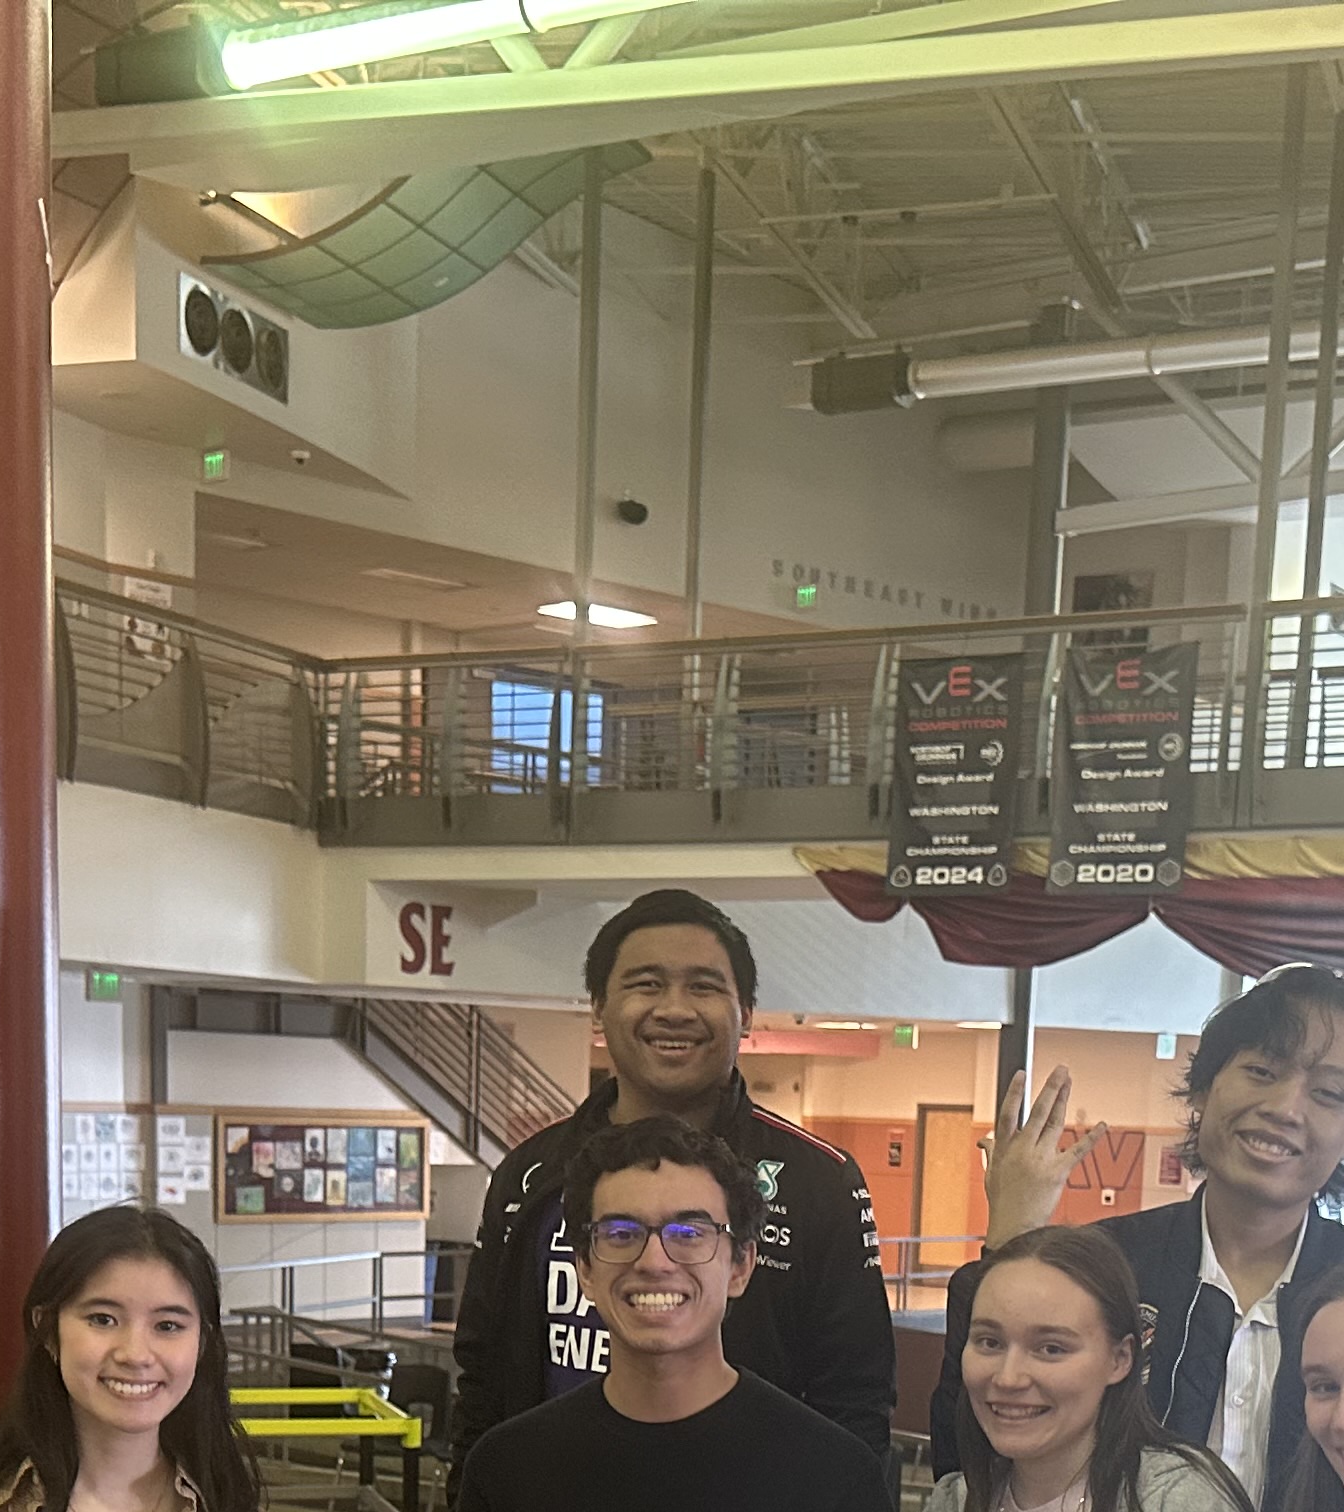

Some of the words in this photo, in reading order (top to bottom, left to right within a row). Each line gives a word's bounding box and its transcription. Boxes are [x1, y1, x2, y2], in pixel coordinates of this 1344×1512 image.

[1080, 659, 1179, 696] VEX
[911, 666, 1008, 705] VEX
[1074, 711, 1179, 725] COMPETITION
[908, 718, 1008, 732] COMPETITION
[957, 772, 994, 783] Award
[1124, 767, 1165, 778] Award
[908, 804, 1000, 817] WASHINGTON
[1073, 801, 1169, 813] WASHINGTON
[931, 834, 969, 845] STATE
[1097, 832, 1136, 843] STATE
[905, 844, 998, 857] CHAMPIONSHIP
[1068, 842, 1167, 854] CHAMPIONSHIP
[915, 866, 984, 885] 2024
[1076, 864, 1154, 883] 2020
[400, 902, 454, 976] SE
